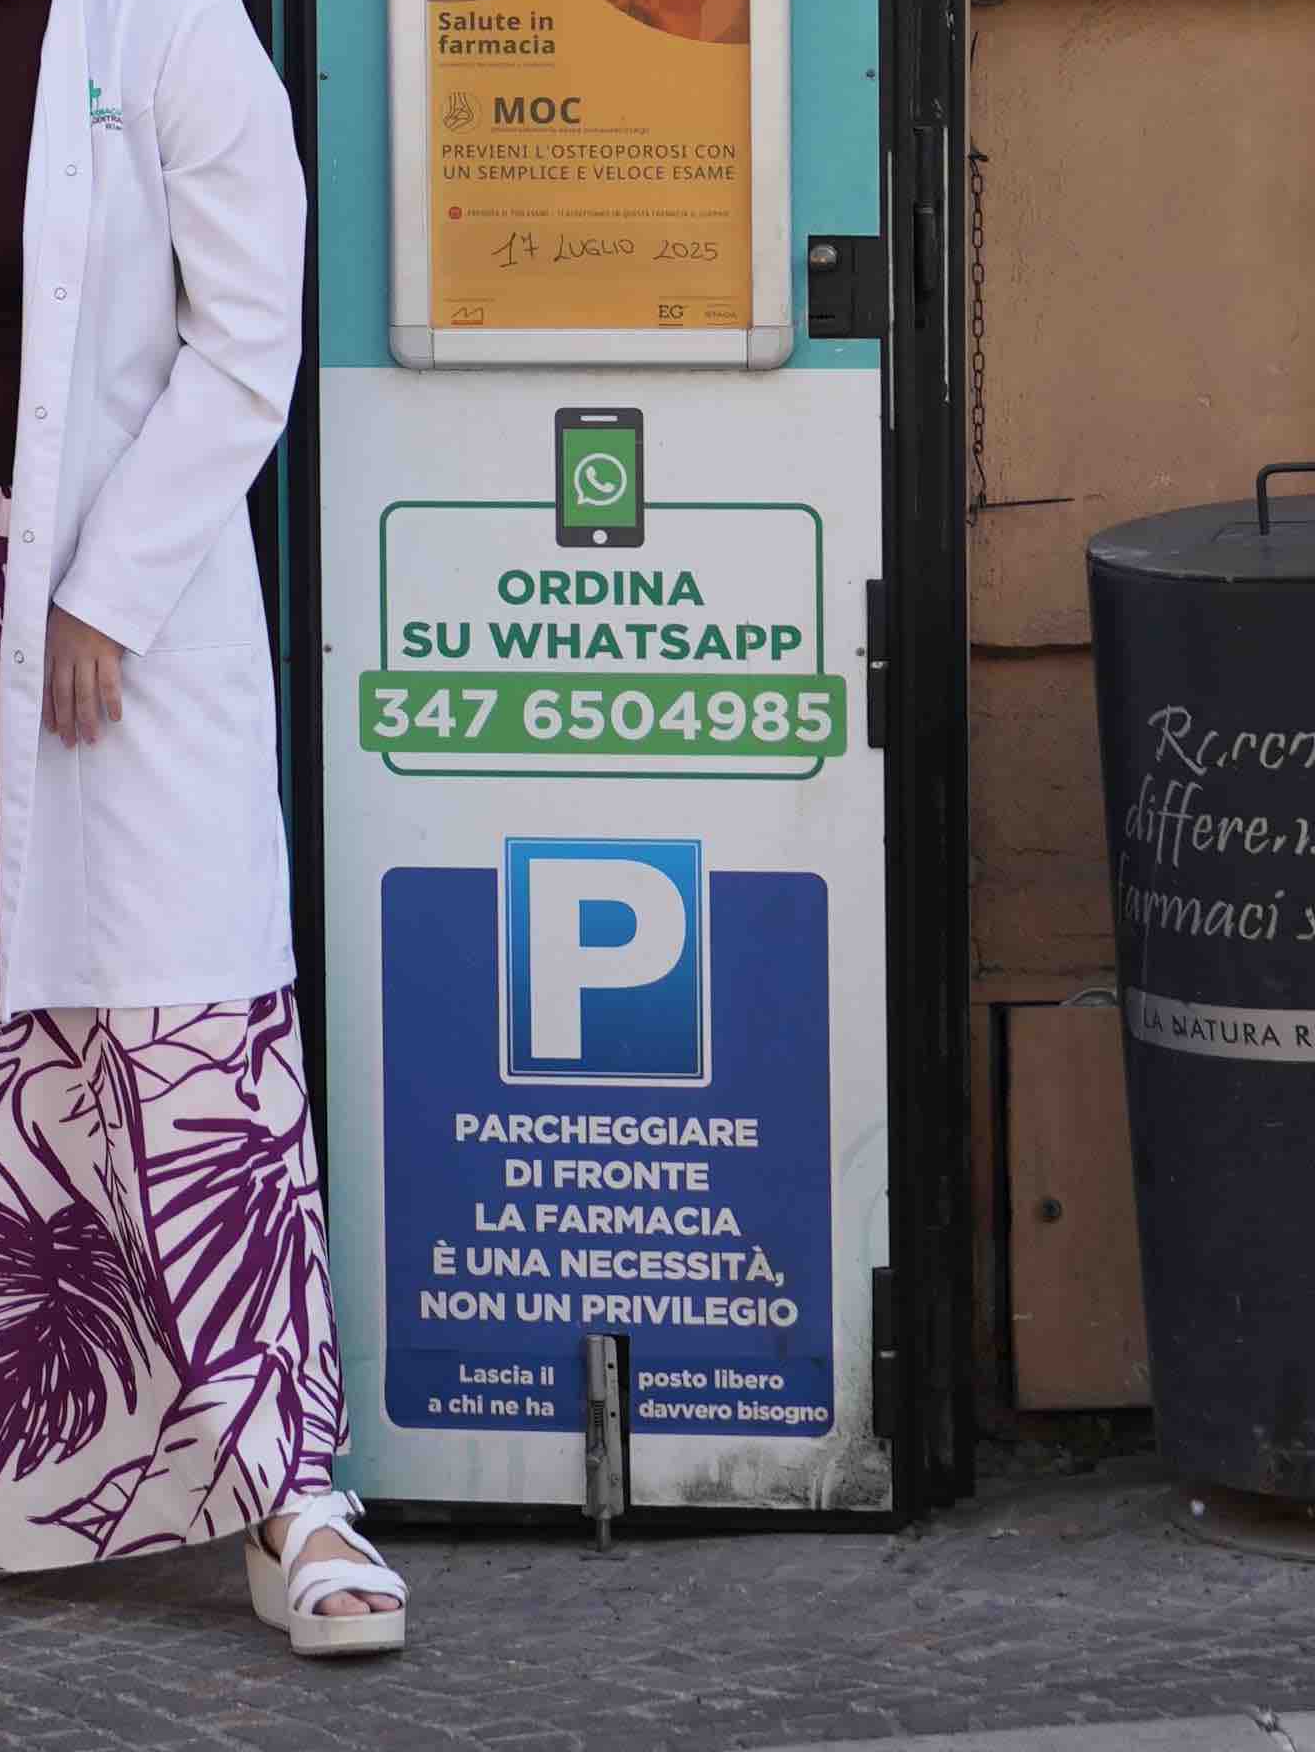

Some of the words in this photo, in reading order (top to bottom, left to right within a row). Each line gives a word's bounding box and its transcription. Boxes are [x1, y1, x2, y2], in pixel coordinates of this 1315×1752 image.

[437, 11, 521, 32] Salute
[530, 11, 554, 32] in
[437, 34, 556, 55] farmacia
[493, 95, 583, 126] MOC
[442, 144, 528, 160] PREVIENI
[535, 144, 687, 160] L'OSTEOPOROSI
[694, 144, 737, 160] CON
[443, 165, 471, 181] UN
[478, 165, 569, 181] SEMPLICE
[577, 165, 587, 180] E
[594, 165, 664, 180] VELOCE
[672, 164, 735, 180] ESAME
[491, 231, 540, 268] 17
[553, 233, 636, 262] LUGLIO
[652, 239, 719, 261] 2025
[658, 304, 684, 319] EG
[497, 569, 705, 606] ORDINA
[401, 621, 470, 658] SU
[489, 622, 803, 660] WHATSAPP
[373, 688, 498, 738] 347
[522, 689, 833, 742] 6504985
[528, 858, 686, 1059] P
[1143, 1007, 1164, 1033] LA
[1171, 1015, 1282, 1048] NATURA
[455, 1112, 760, 1148] PARCHEGGIARE
[506, 1159, 543, 1188] DI
[554, 1159, 710, 1191] FRONTE
[475, 1204, 526, 1233] LA
[536, 1205, 742, 1238] FARMACIA
[433, 1240, 455, 1276] È
[467, 1248, 550, 1278] UNA
[561, 1245, 785, 1287] NECESSITÀ,
[420, 1291, 506, 1322] NON
[516, 1293, 571, 1323] UN
[582, 1294, 799, 1328] PRIVILEGIO
[459, 1363, 534, 1386] Lascia
[540, 1364, 555, 1386] il
[638, 1368, 709, 1397] posto
[713, 1367, 784, 1391] libero
[427, 1400, 443, 1416] a
[448, 1394, 485, 1417] chi
[490, 1400, 520, 1417] ne
[525, 1395, 555, 1418] ha
[638, 1399, 733, 1421] davvero
[737, 1399, 829, 1426] bisogno
